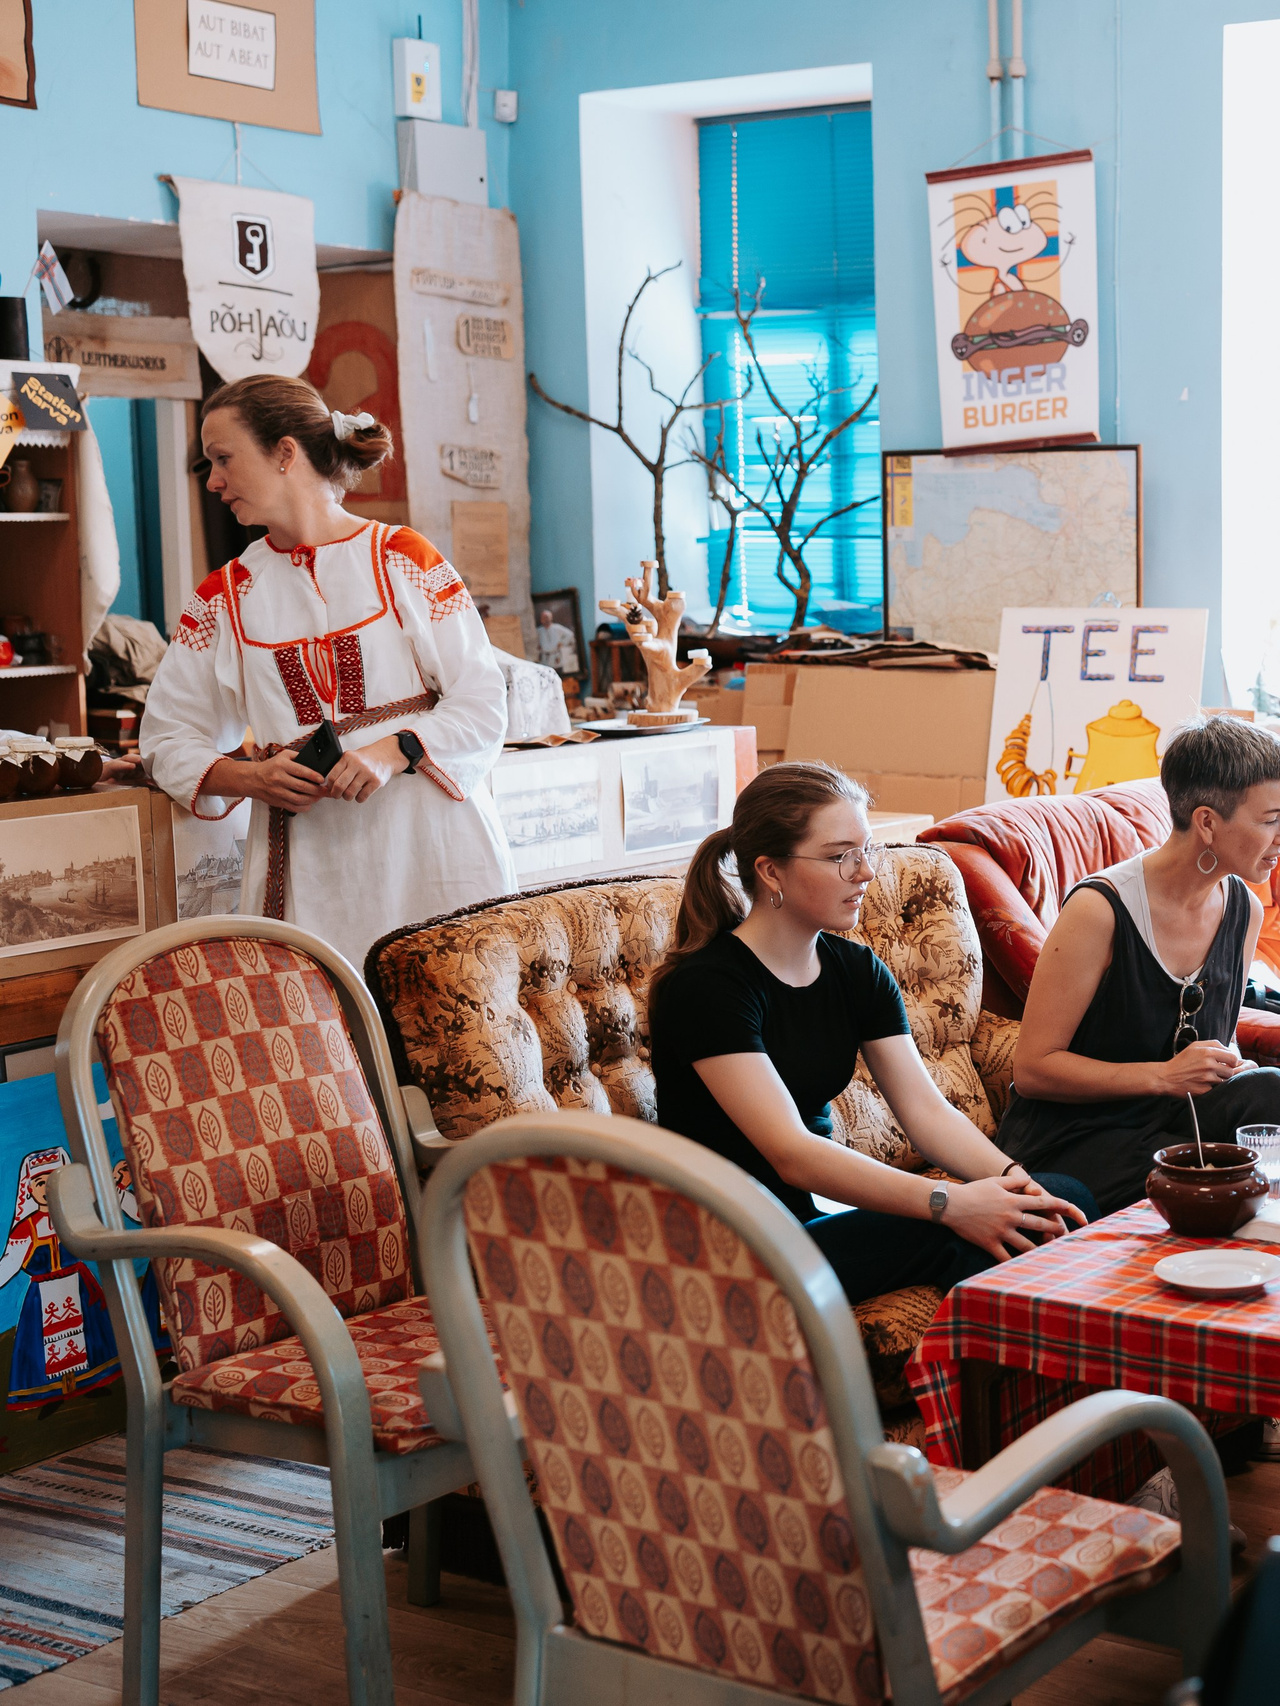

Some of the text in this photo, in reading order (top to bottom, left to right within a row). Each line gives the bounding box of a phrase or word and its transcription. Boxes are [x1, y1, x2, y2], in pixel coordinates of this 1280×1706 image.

[198, 13, 266, 42] AUT BIBAT
[194, 40, 269, 70] AUT ABEAT
[26, 376, 82, 424] Station
[962, 362, 1067, 401] INGER
[20, 383, 68, 426] Narva
[963, 397, 1068, 429] BURGER
[1022, 624, 1168, 682] TEE
